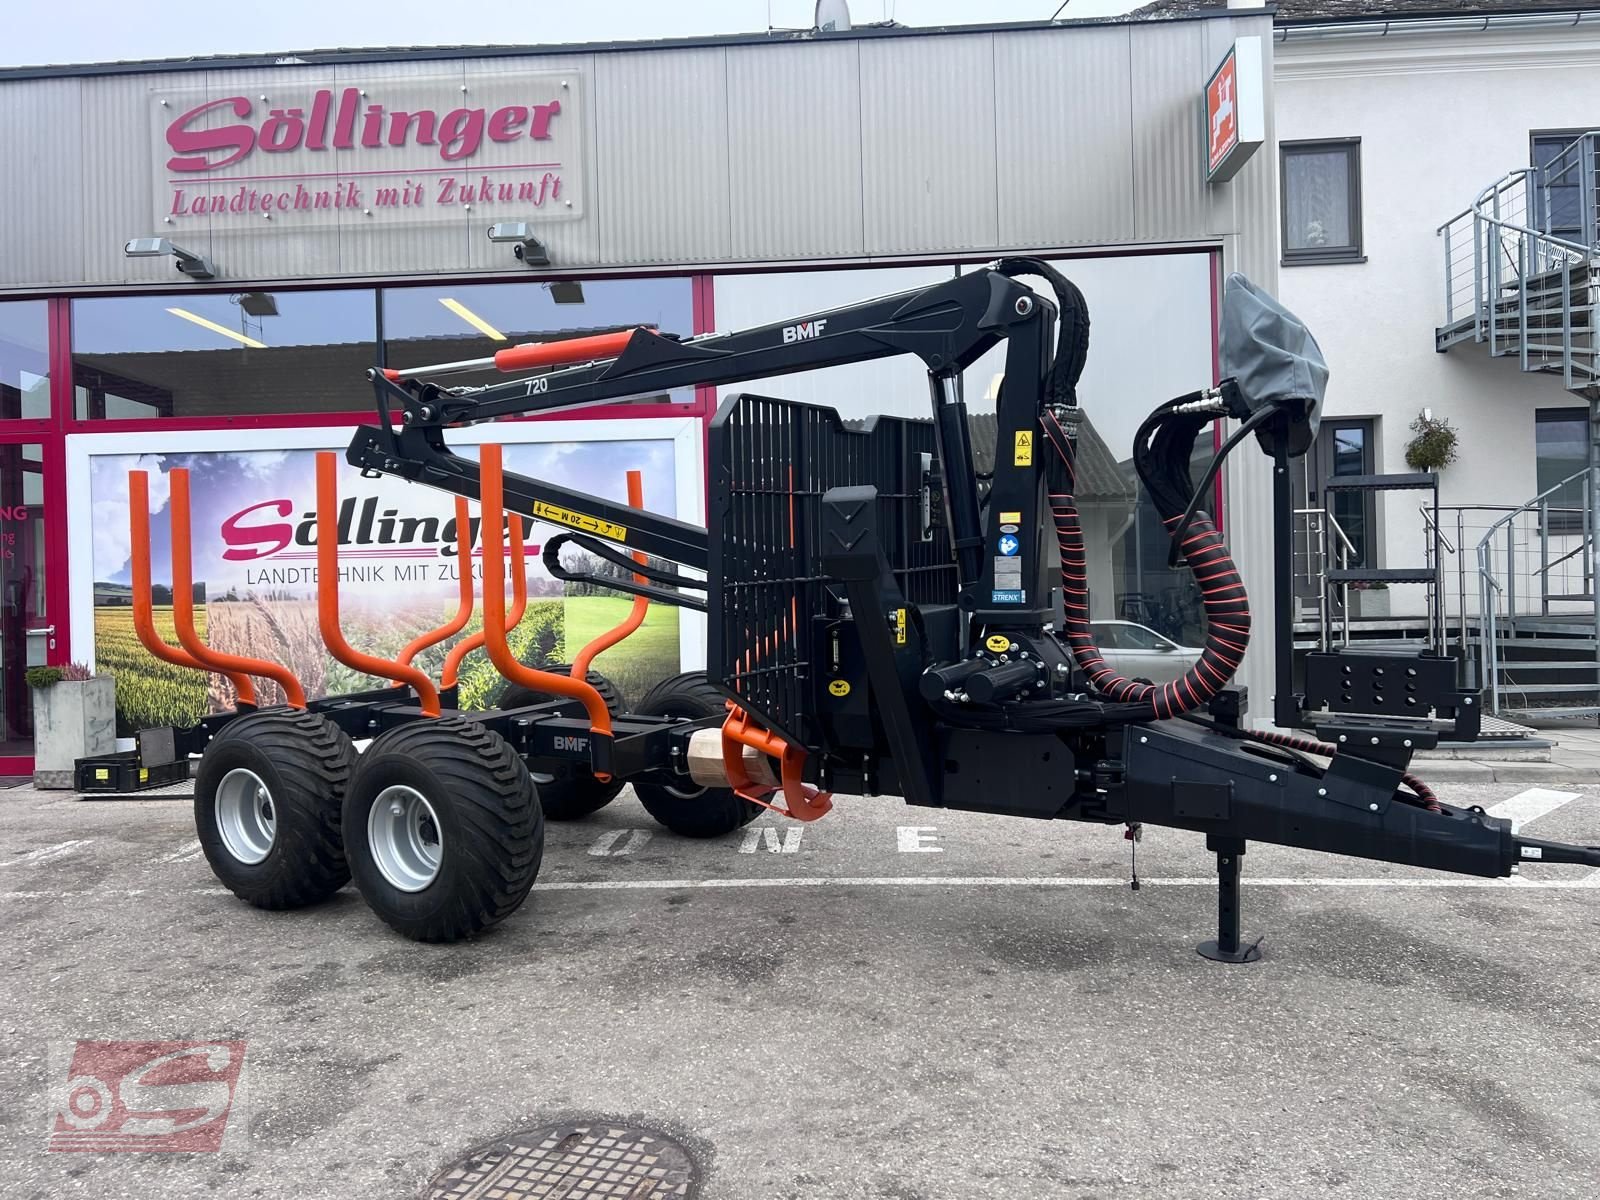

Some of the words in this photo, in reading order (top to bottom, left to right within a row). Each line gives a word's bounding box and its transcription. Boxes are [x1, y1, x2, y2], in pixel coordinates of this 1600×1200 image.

[166, 88, 560, 172] Söllinger
[171, 182, 362, 215] Landtechnik
[375, 179, 424, 206] mit
[437, 172, 562, 206] Zukunft
[783, 319, 827, 344] BMF
[524, 377, 549, 396] 720
[561, 512, 569, 521] M
[571, 515, 581, 525] 20
[247, 566, 385, 585] LANDTEHNIK
[394, 564, 429, 581] MIT
[553, 735, 588, 752] BMF
